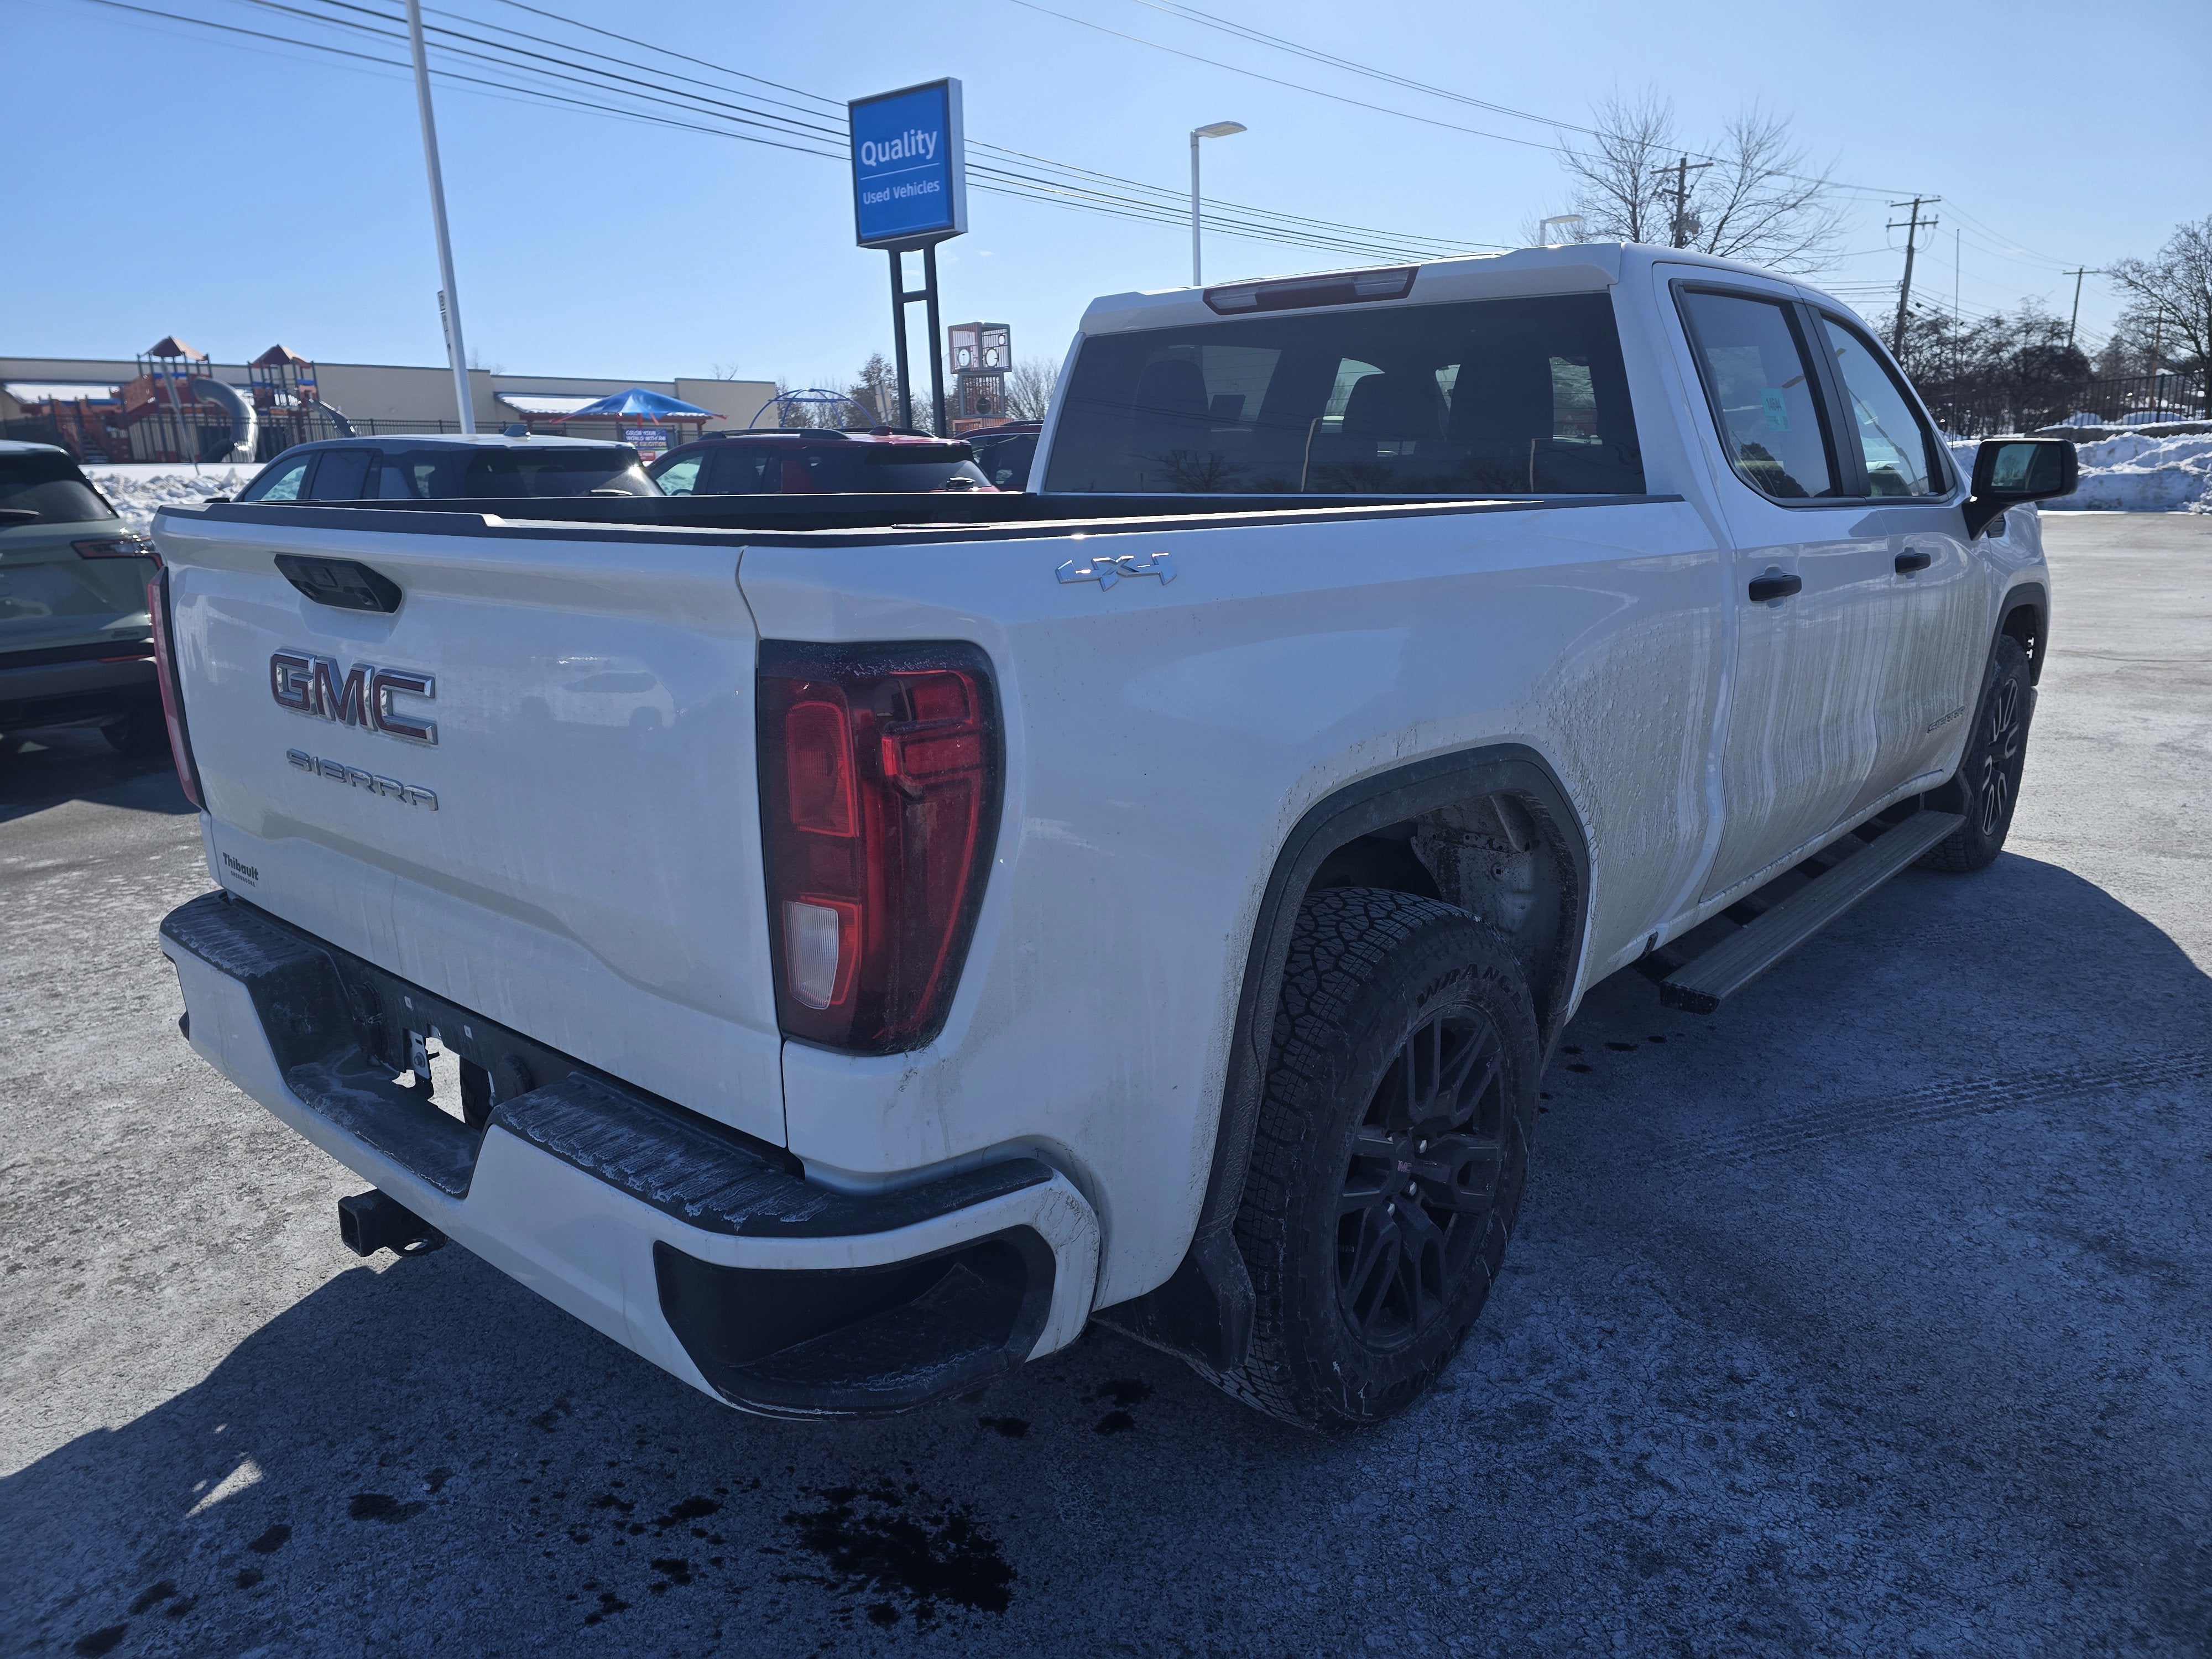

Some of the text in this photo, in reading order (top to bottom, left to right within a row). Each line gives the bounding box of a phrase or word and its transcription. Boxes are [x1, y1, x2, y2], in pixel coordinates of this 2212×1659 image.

[861, 129, 938, 166] Quality
[863, 180, 940, 205] Used Vehicles
[270, 648, 439, 745] GMC
[286, 748, 439, 811] SIERRA
[222, 852, 259, 881] Thibault
